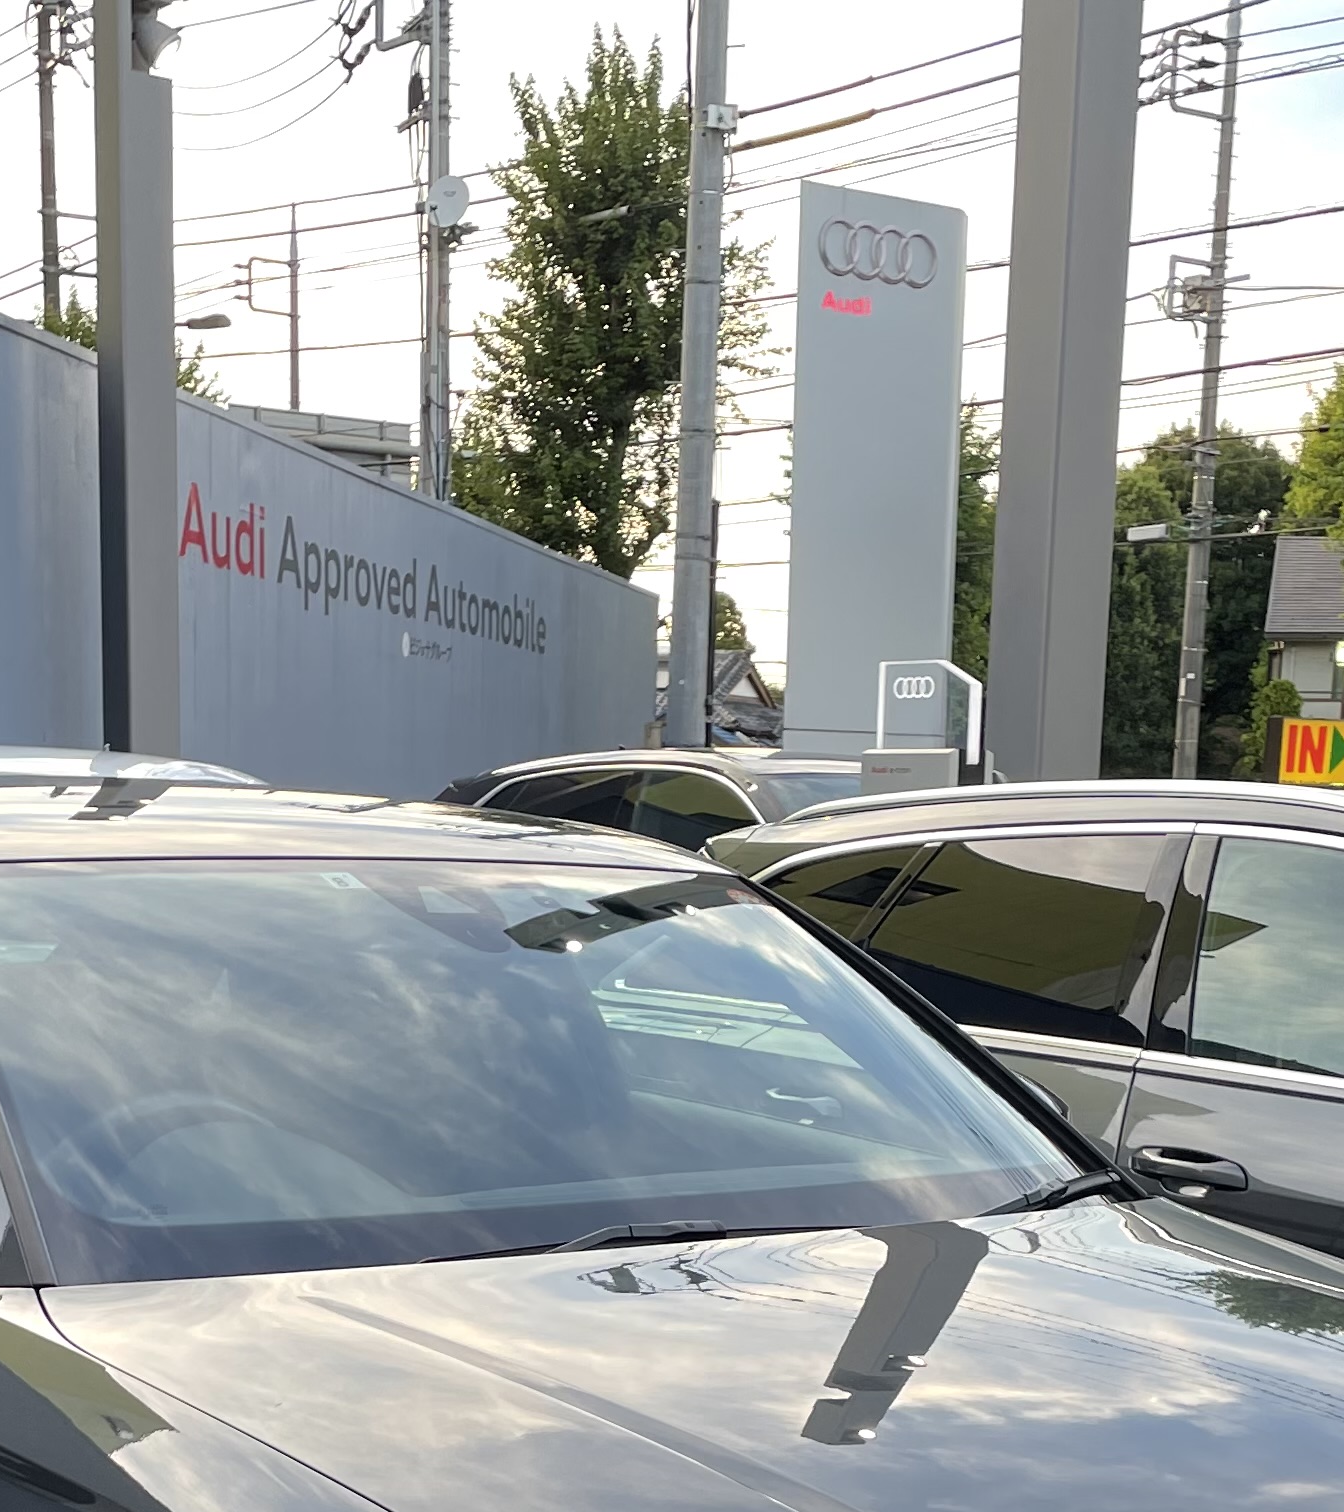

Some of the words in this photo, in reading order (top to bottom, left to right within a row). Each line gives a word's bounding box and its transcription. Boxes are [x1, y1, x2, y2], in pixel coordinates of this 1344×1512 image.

[820, 290, 872, 317] Audi
[179, 482, 265, 579] Audi
[276, 515, 417, 618] Approved
[424, 564, 547, 654] Automobile
[1285, 724, 1328, 774] IN
